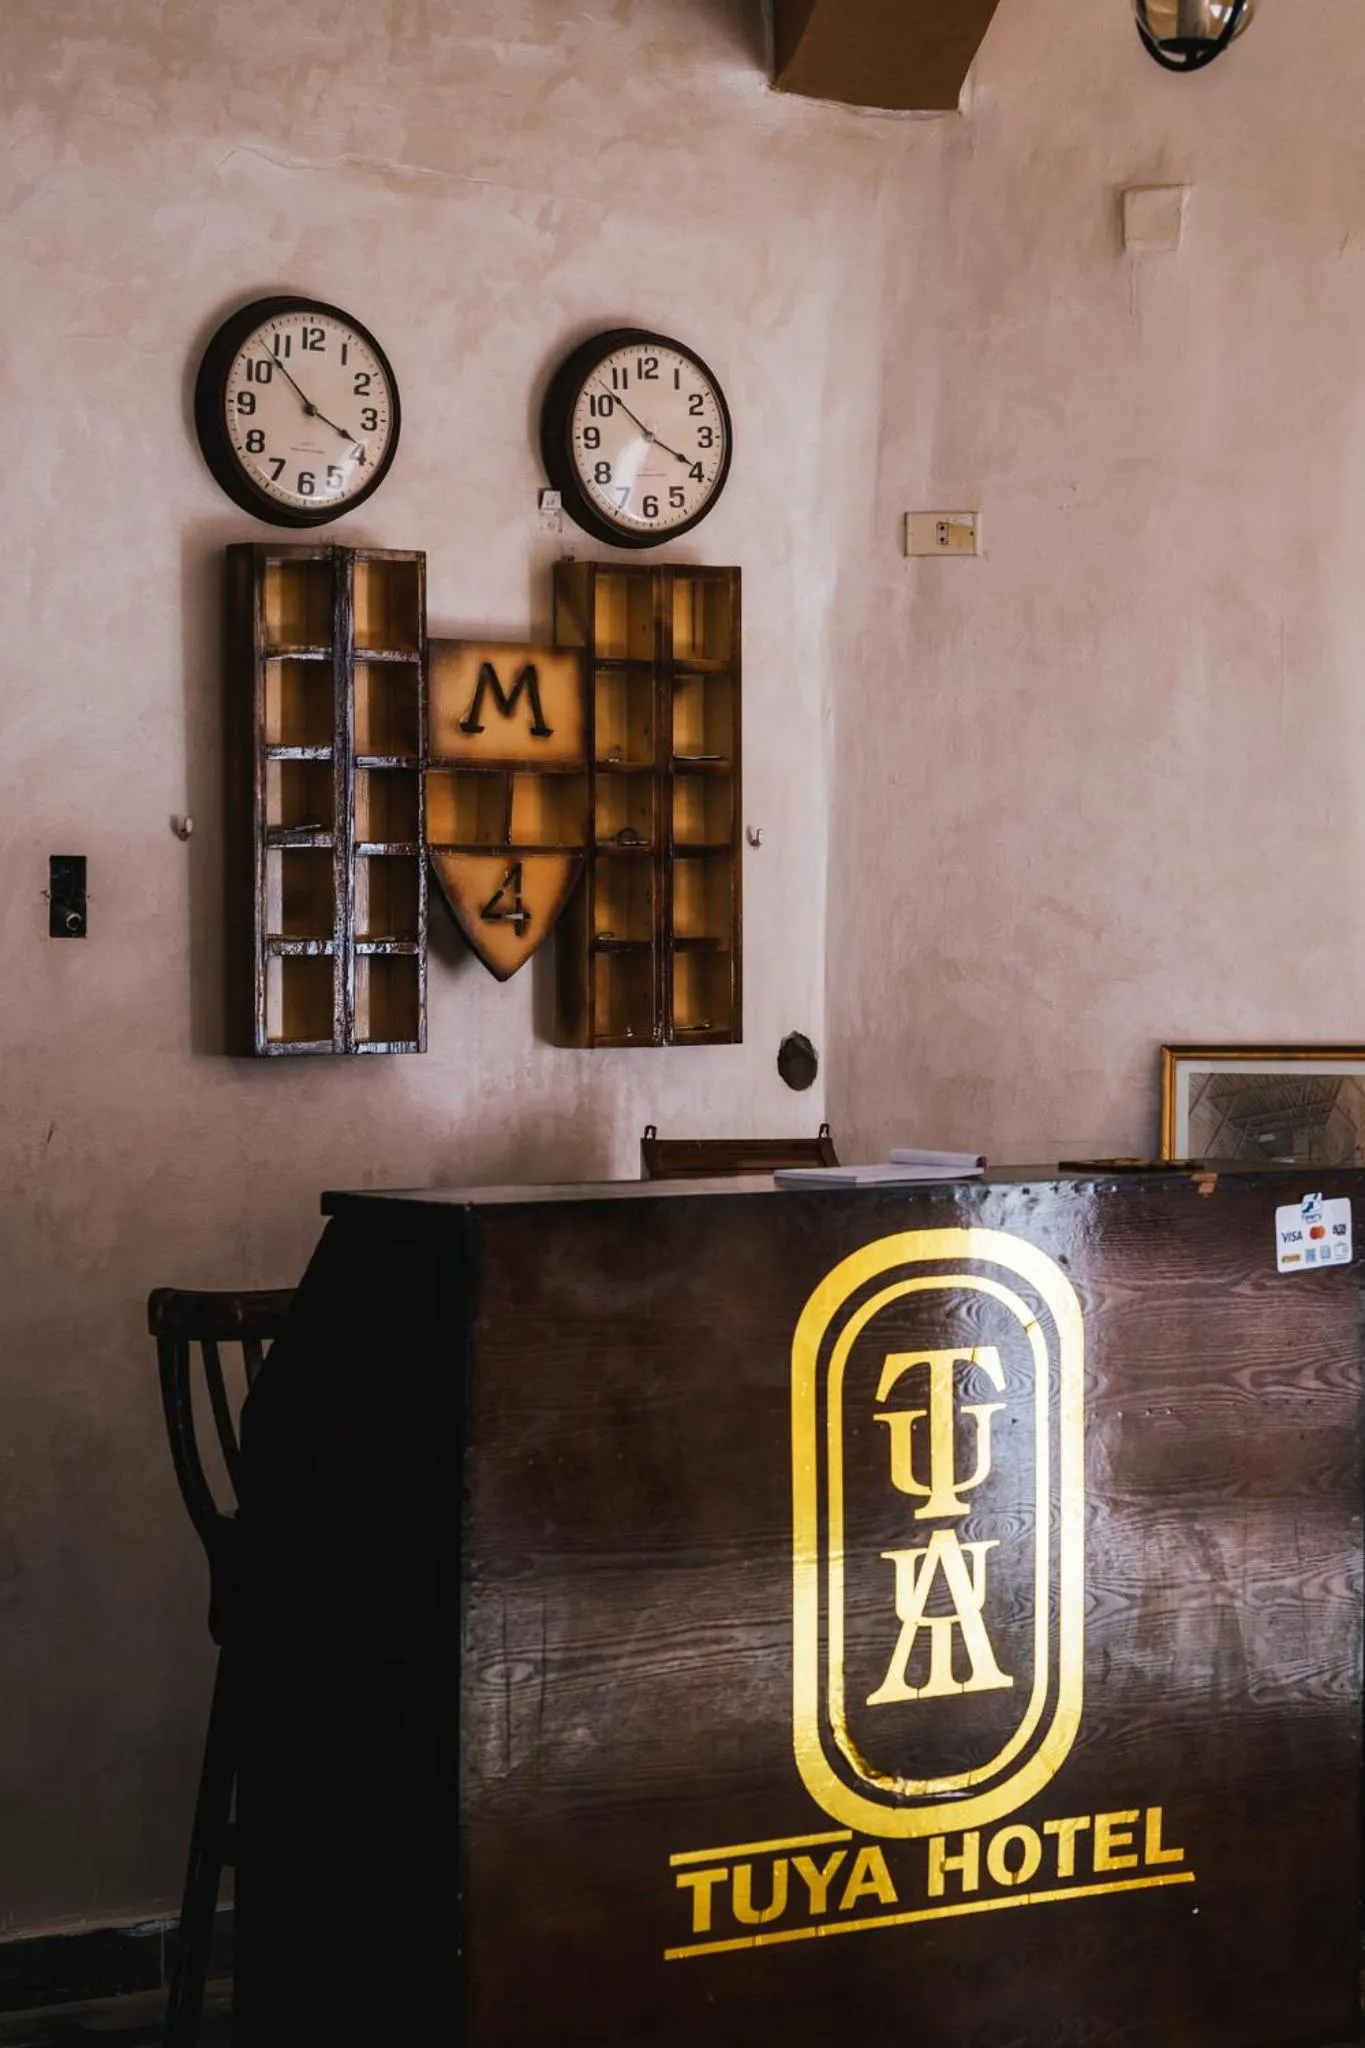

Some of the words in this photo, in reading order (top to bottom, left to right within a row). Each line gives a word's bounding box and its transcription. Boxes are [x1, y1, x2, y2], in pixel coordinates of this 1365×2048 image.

[274, 333, 291, 358] 11
[302, 327, 326, 352] 12
[341, 343, 347, 366] 1
[247, 358, 273, 384] 10
[612, 367, 628, 390] 11
[637, 357, 659, 380] 12
[674, 368, 680, 390] 1
[354, 372, 371, 396] 2
[237, 391, 256, 415] 9
[590, 394, 614, 417] 10
[688, 394, 704, 416] 2
[360, 408, 378, 431] 3
[245, 429, 265, 454] 8
[583, 427, 601, 449] 9
[697, 426, 713, 449] 3
[350, 443, 367, 467] 4
[269, 457, 287, 481] 7
[326, 464, 344, 489] 5
[594, 461, 612, 484] 8
[688, 461, 705, 483] 4
[298, 471, 315, 495] 6
[615, 486, 631, 508] 7
[642, 495, 659, 518] 6
[668, 485, 685, 508] 5
[459, 662, 555, 737] M
[1281, 1230, 1303, 1244] VISA
[676, 1845, 899, 1933] TUYA
[928, 1806, 1185, 1898] HOTEL
